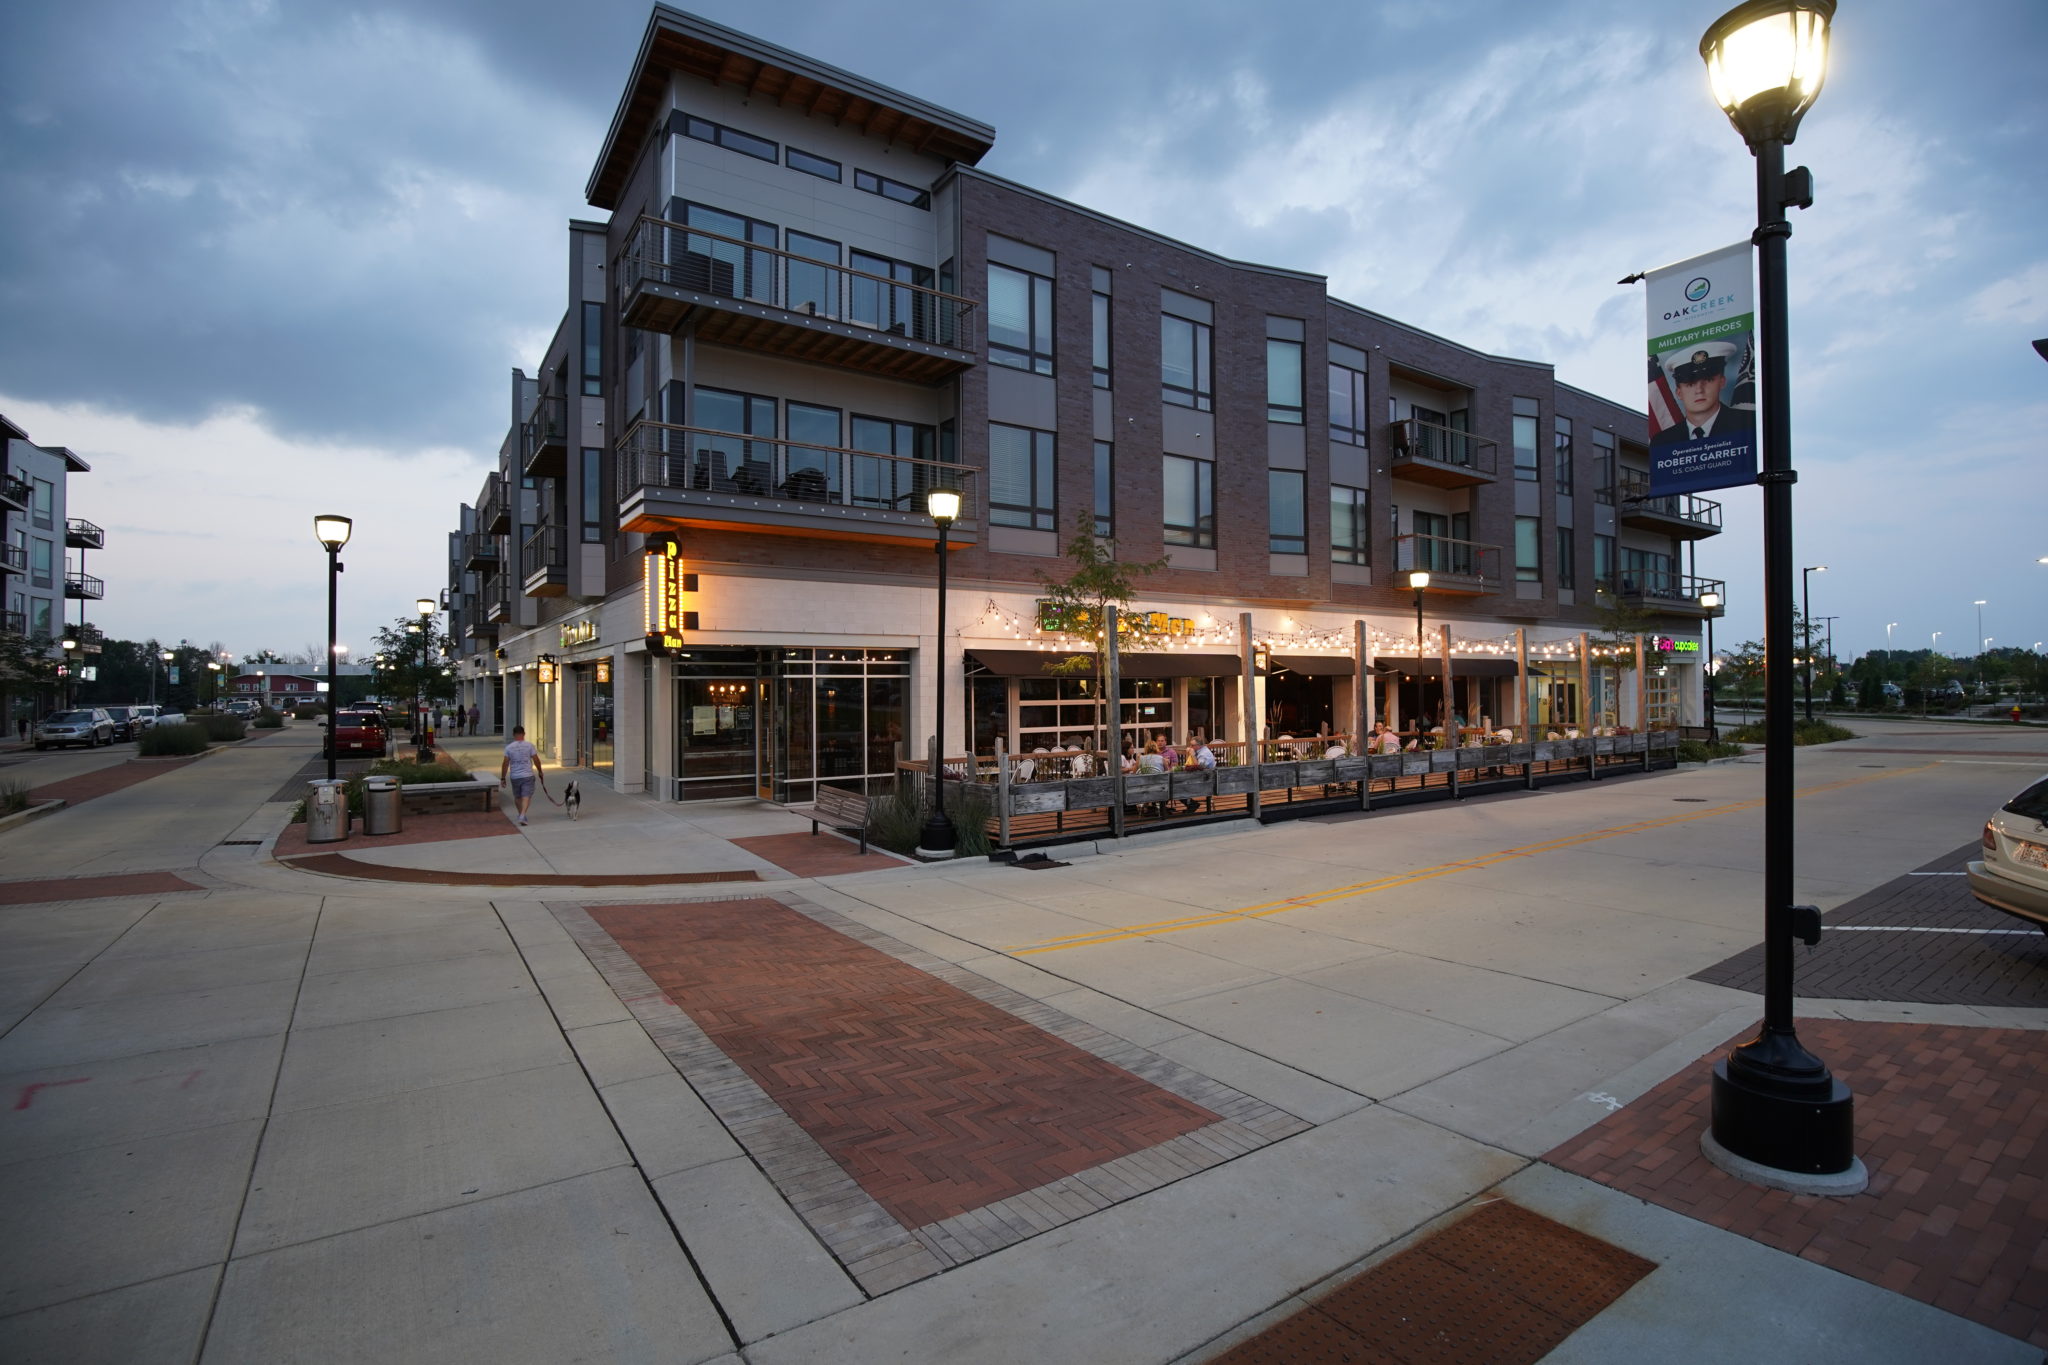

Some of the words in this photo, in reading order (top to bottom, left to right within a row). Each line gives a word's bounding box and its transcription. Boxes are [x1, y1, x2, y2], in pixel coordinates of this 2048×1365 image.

[1658, 331, 1700, 349] MILITARY
[1702, 320, 1742, 338] HEROES
[1672, 446, 1702, 456] Operations
[1704, 440, 1732, 450] Specialist
[1657, 454, 1698, 469] ROBERT
[1700, 446, 1749, 462] GARRETT
[1684, 464, 1707, 473] COAST
[1707, 460, 1732, 469] GUARD
[663, 634, 682, 648] Man
